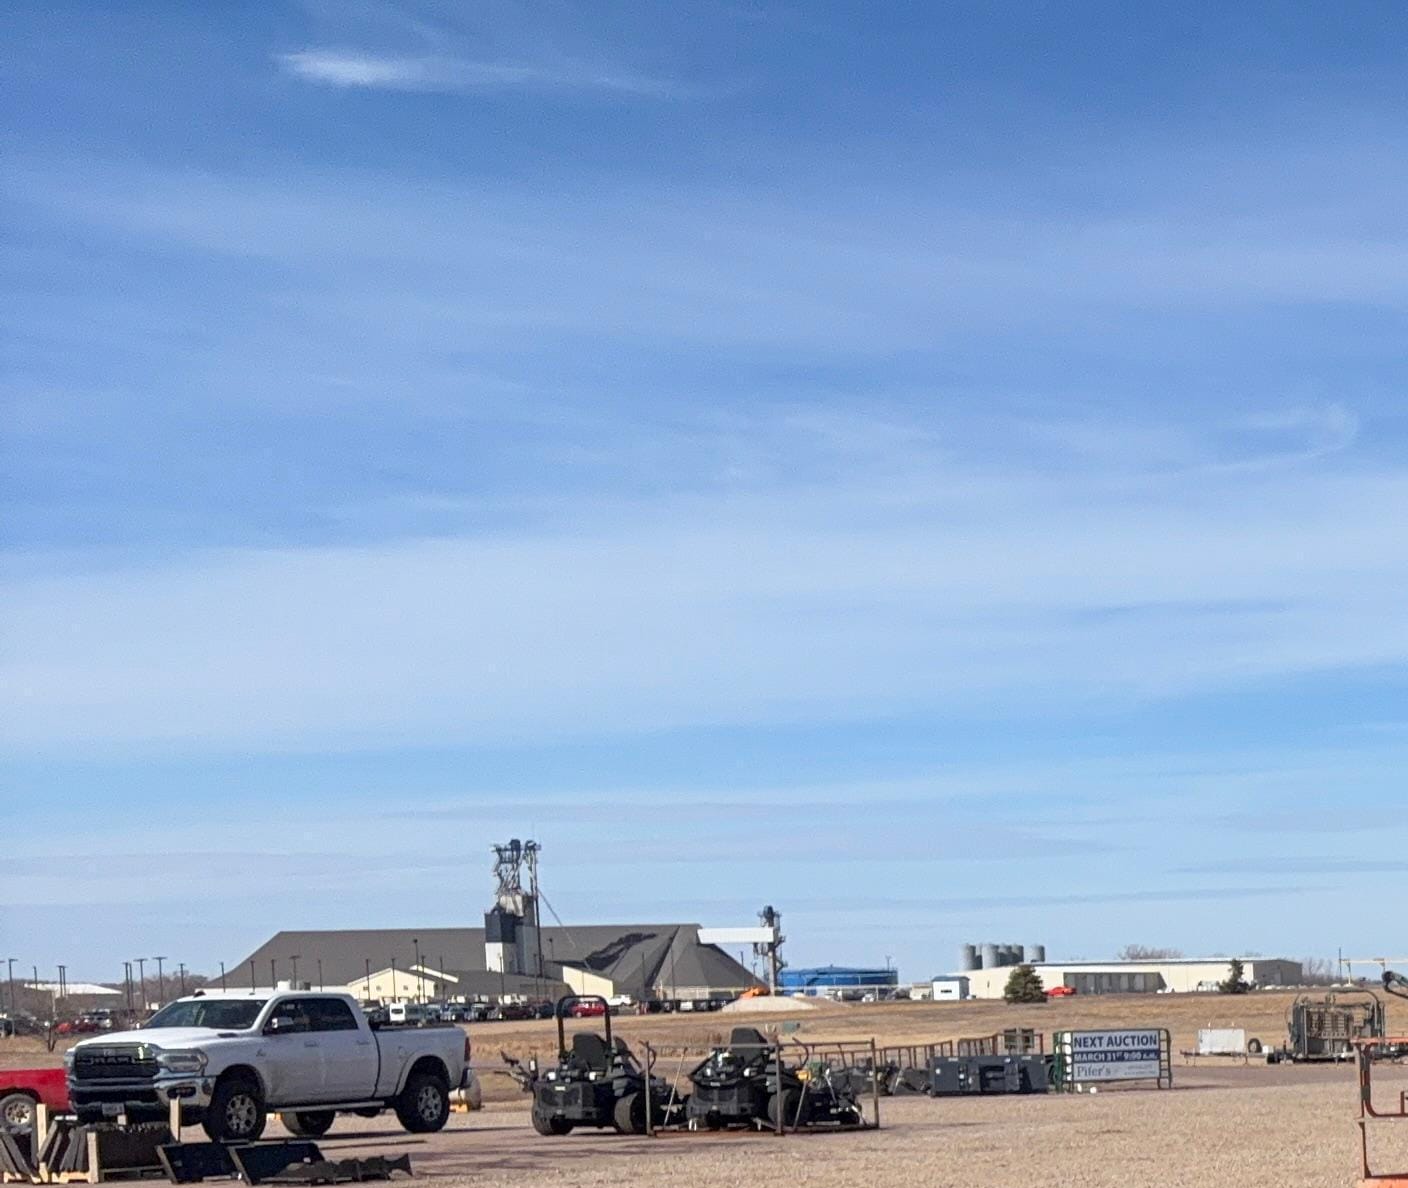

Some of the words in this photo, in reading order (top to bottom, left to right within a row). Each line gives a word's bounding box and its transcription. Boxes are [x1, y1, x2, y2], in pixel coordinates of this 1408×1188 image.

[1074, 1036, 1104, 1048] NEXT
[1106, 1034, 1157, 1047] AUCTION
[1073, 1053, 1105, 1061] MARCH
